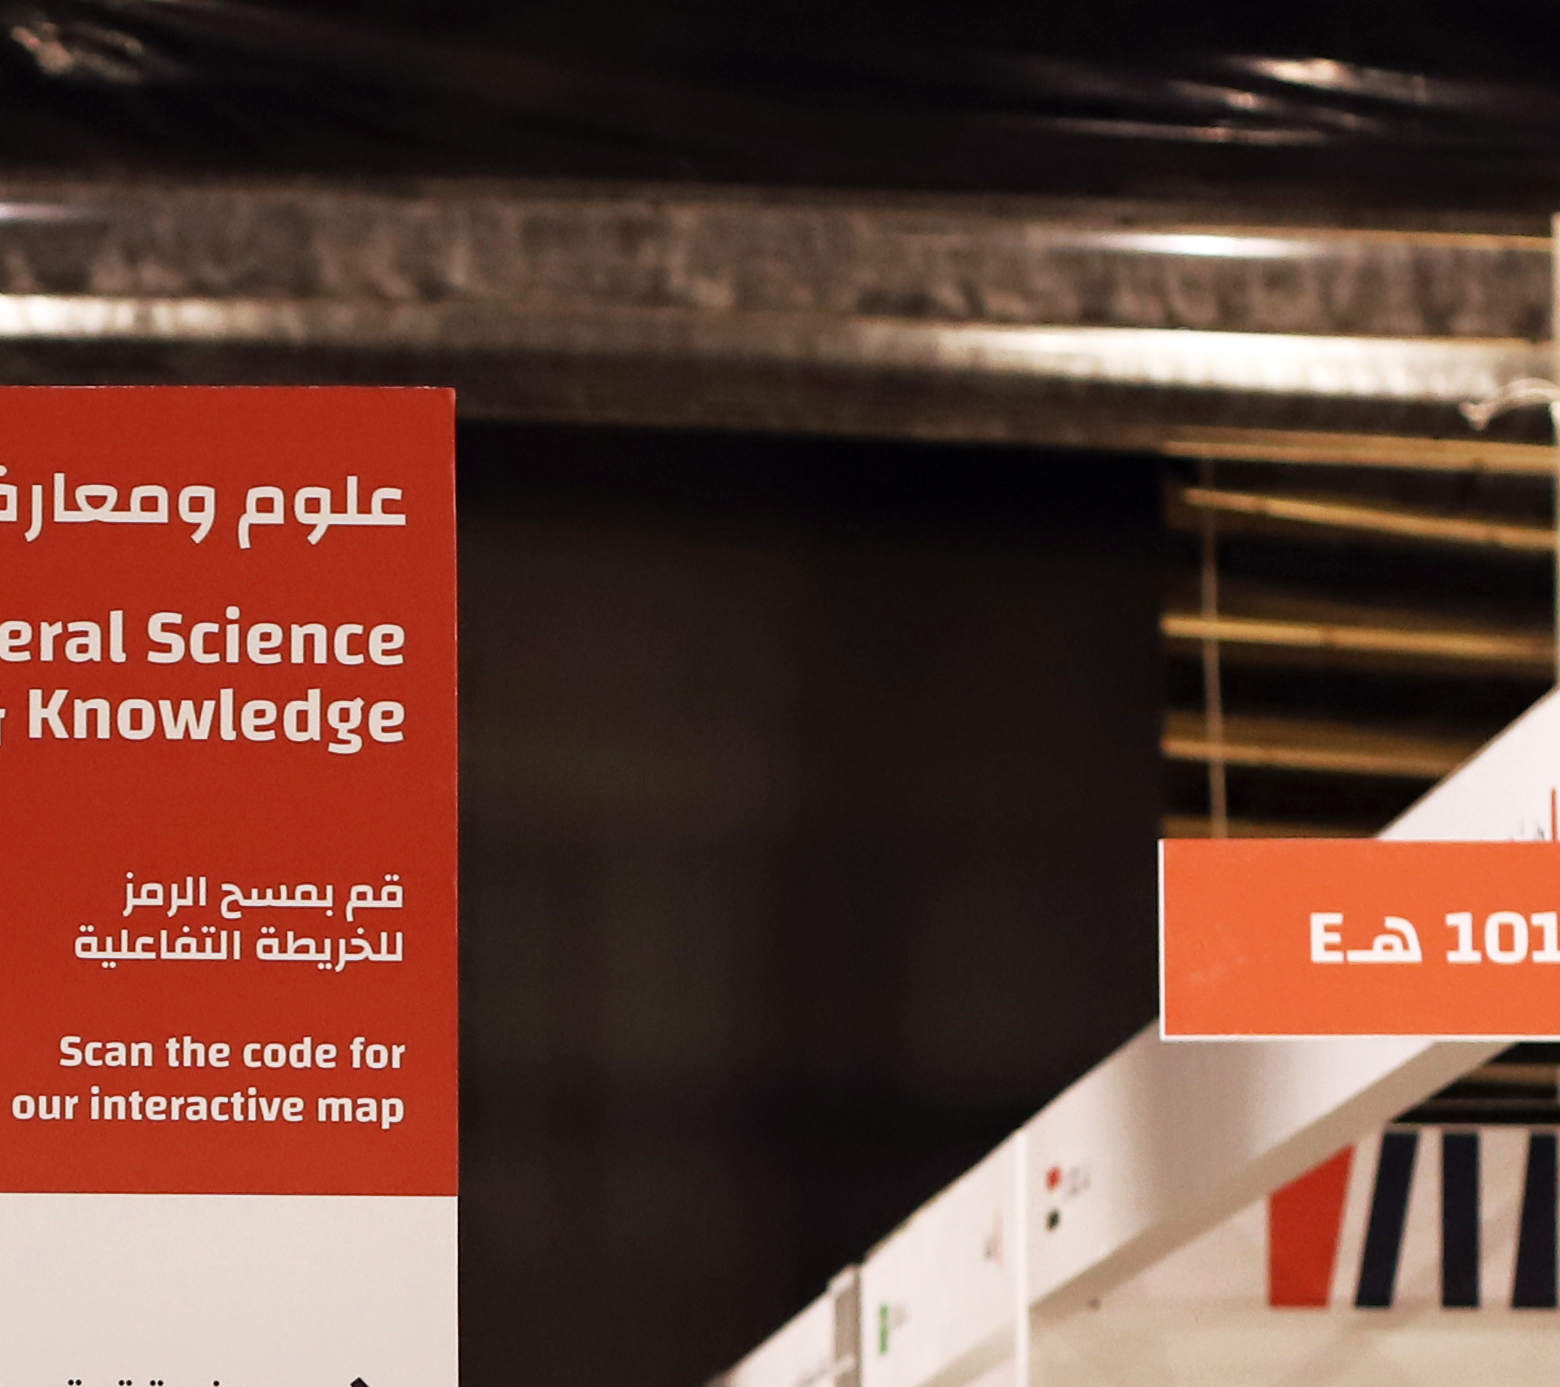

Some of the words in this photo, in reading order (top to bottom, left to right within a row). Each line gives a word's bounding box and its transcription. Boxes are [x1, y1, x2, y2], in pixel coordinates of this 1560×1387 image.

[237, 475, 407, 549] علوم
[147, 605, 405, 666] Science
[28, 687, 405, 755] Knowledge
[122, 871, 207, 918] الرمز
[220, 883, 334, 920] بمسح
[345, 873, 403, 921] قم
[74, 924, 241, 969] التفاعلية
[255, 926, 403, 973] للخريطة
[59, 1035, 153, 1067] Scan
[165, 1035, 231, 1068] the
[243, 1036, 337, 1069] code
[349, 1036, 406, 1069] for
[11, 1094, 79, 1120] our
[90, 1085, 304, 1122] interactive
[317, 1097, 404, 1130] map
